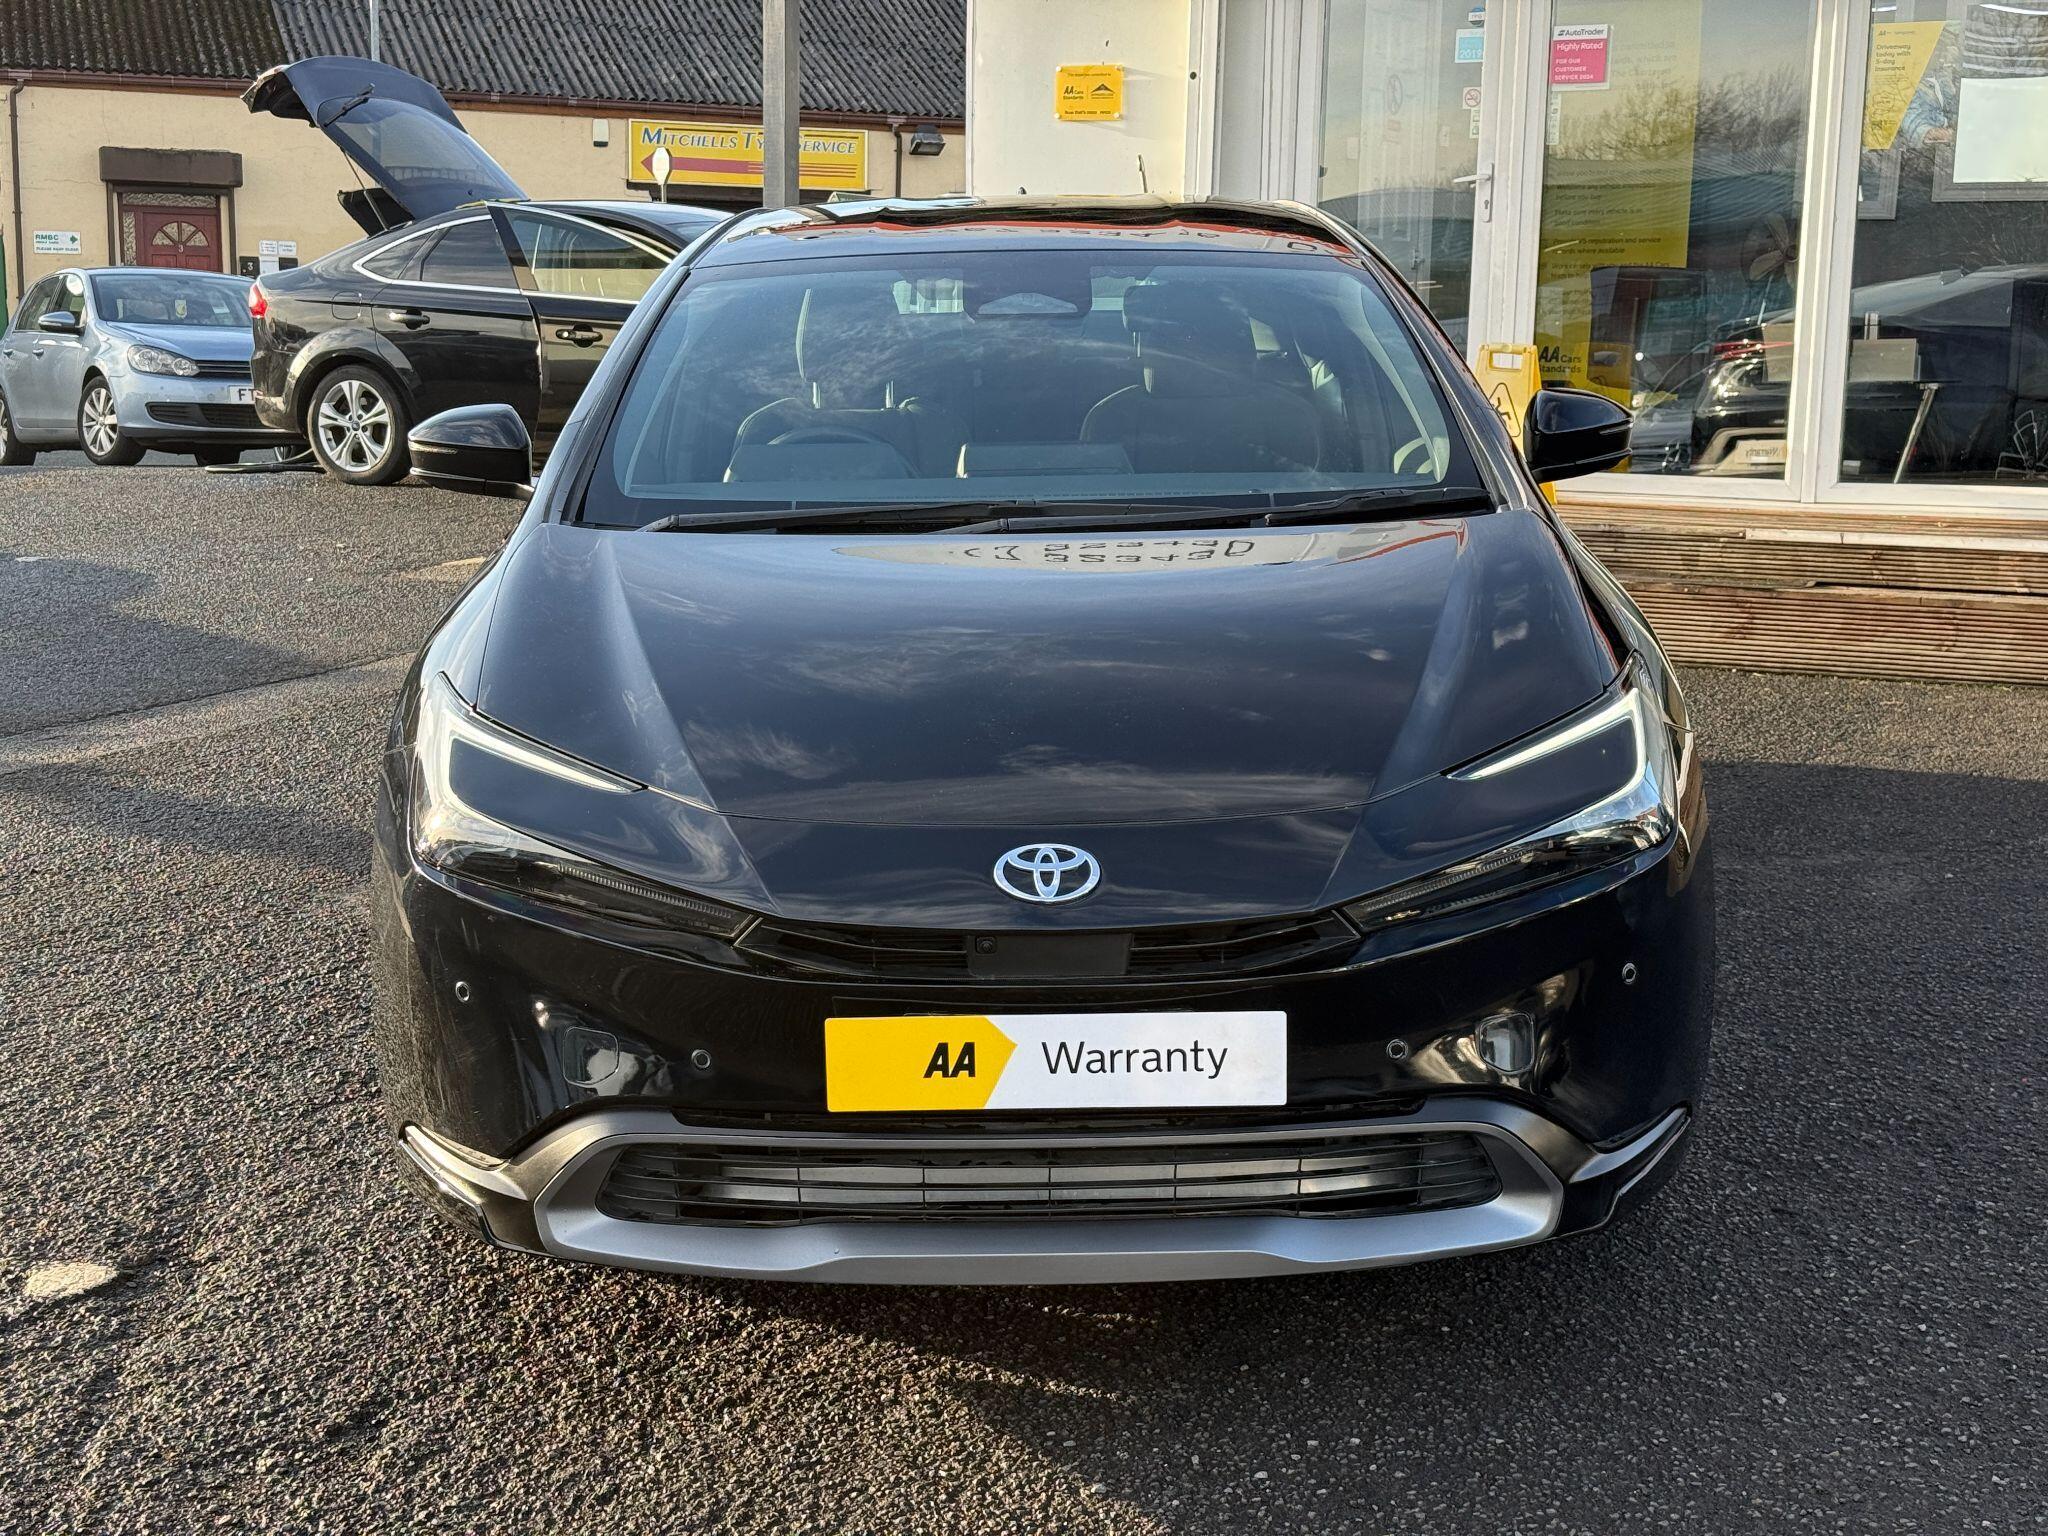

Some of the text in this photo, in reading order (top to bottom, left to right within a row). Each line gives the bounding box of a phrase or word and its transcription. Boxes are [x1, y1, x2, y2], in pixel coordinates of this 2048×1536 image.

[1565, 28, 1604, 36] AutoTrader
[1556, 42, 1603, 52] Highly Rated
[1063, 85, 1075, 95] AA
[742, 132, 764, 149] TY
[799, 136, 857, 154] ERVICE
[247, 261, 254, 271] 3
[1540, 345, 1582, 363] AA Cars
[923, 1039, 1229, 1080] AA Warranty
